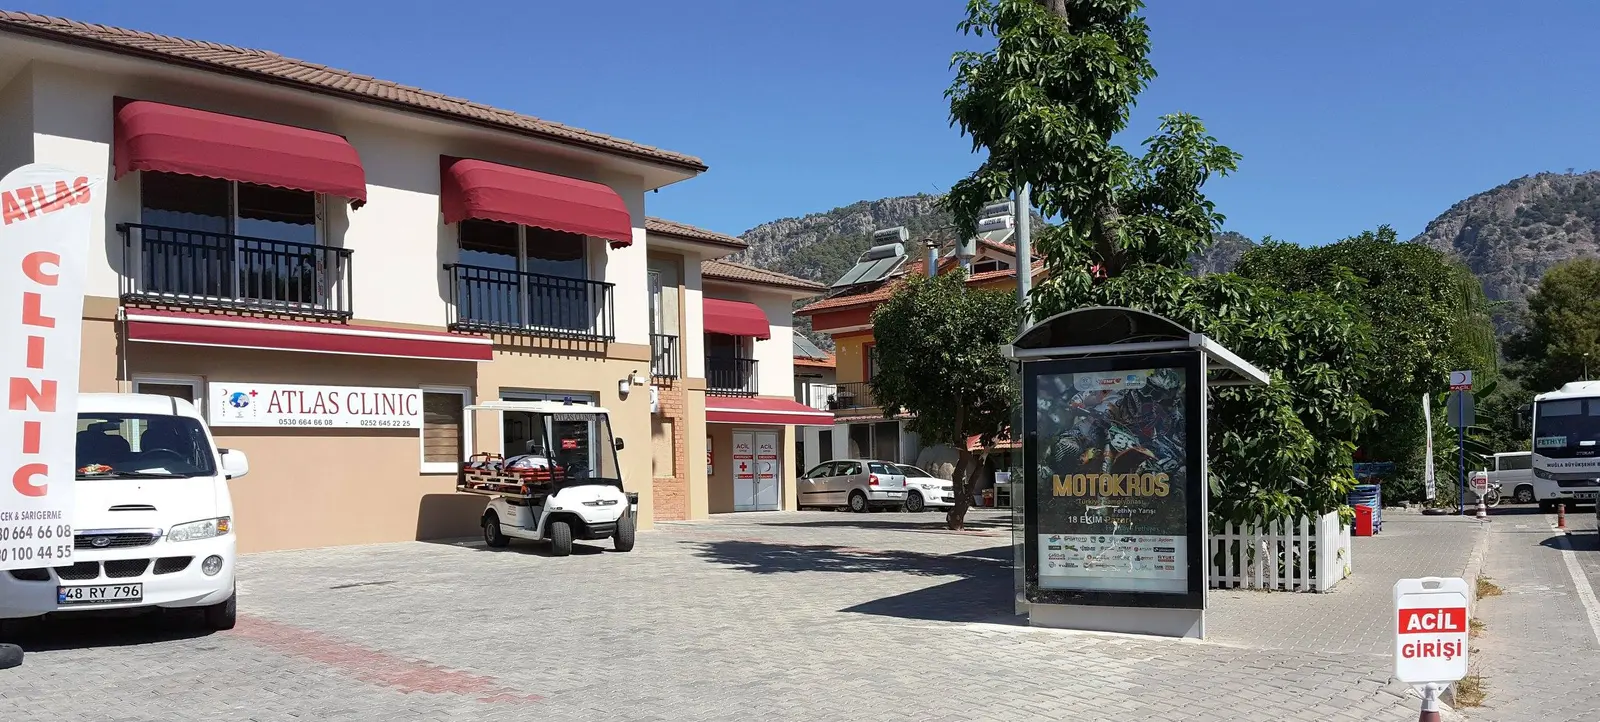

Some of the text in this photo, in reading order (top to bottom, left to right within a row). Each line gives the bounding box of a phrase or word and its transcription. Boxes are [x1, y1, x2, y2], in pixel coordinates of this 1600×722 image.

[1, 176, 91, 225] ATLAS
[9, 251, 60, 498] CLINIC
[267, 389, 339, 415] ATLAS
[346, 391, 418, 416] CLINIC
[279, 418, 333, 426] 0530 664 66 08
[360, 419, 411, 427] 0252 645 22 25
[1052, 472, 1170, 497] MOTOKROS
[1068, 516, 1077, 524] 18
[1080, 515, 1103, 524] EKİM
[12, 526, 33, 540] 664
[37, 525, 52, 539] 66
[56, 524, 71, 538] 08
[12, 546, 33, 561] 100
[37, 545, 52, 559] 44
[56, 545, 71, 559] 55
[66, 585, 139, 599] 48 RY 796
[1407, 610, 1457, 631] ACİL
[1401, 639, 1462, 661] GİRİŞİ
